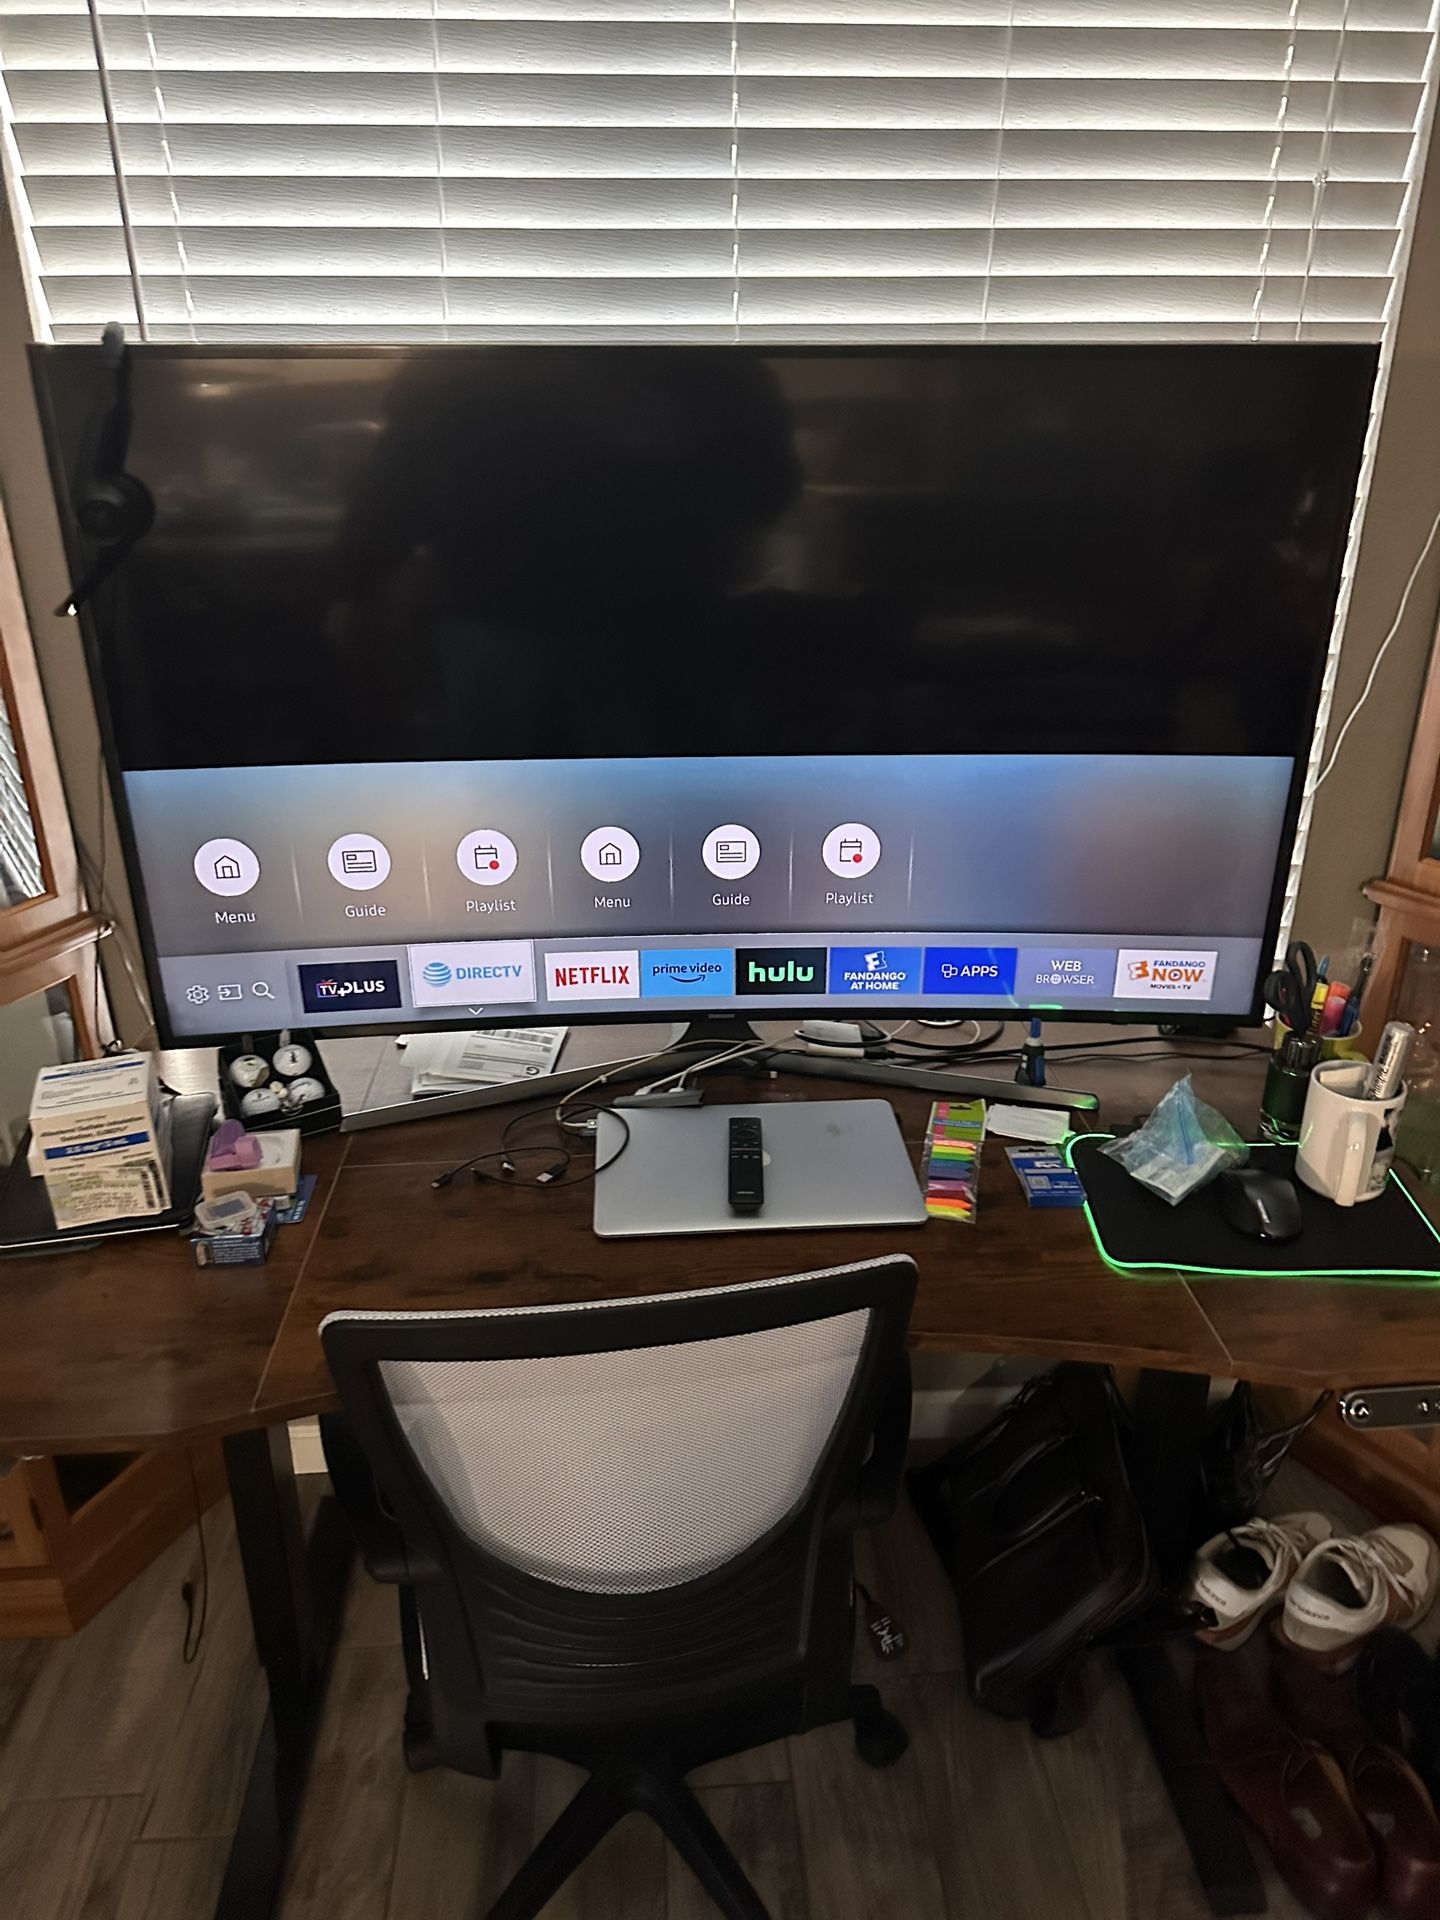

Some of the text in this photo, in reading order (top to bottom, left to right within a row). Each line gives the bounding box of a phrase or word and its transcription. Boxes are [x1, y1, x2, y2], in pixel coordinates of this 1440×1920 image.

[594, 895, 631, 908] Menu
[712, 893, 751, 906] Guide
[825, 892, 874, 907] Playlist
[344, 903, 386, 918] Guide
[466, 899, 517, 915] Playlist
[214, 910, 256, 924] Menu
[652, 962, 722, 978] prime video
[960, 965, 998, 977] APPS
[1050, 960, 1082, 972] WEB
[1153, 960, 1206, 968] FANDANGO
[456, 964, 522, 980] DIRECTV
[555, 965, 630, 987] NETFLIX
[748, 960, 814, 983] hulu
[844, 971, 906, 981] FANDANGO
[1151, 967, 1204, 982] NOW
[850, 981, 899, 990] AT HOME
[1035, 974, 1095, 985] BROWSER
